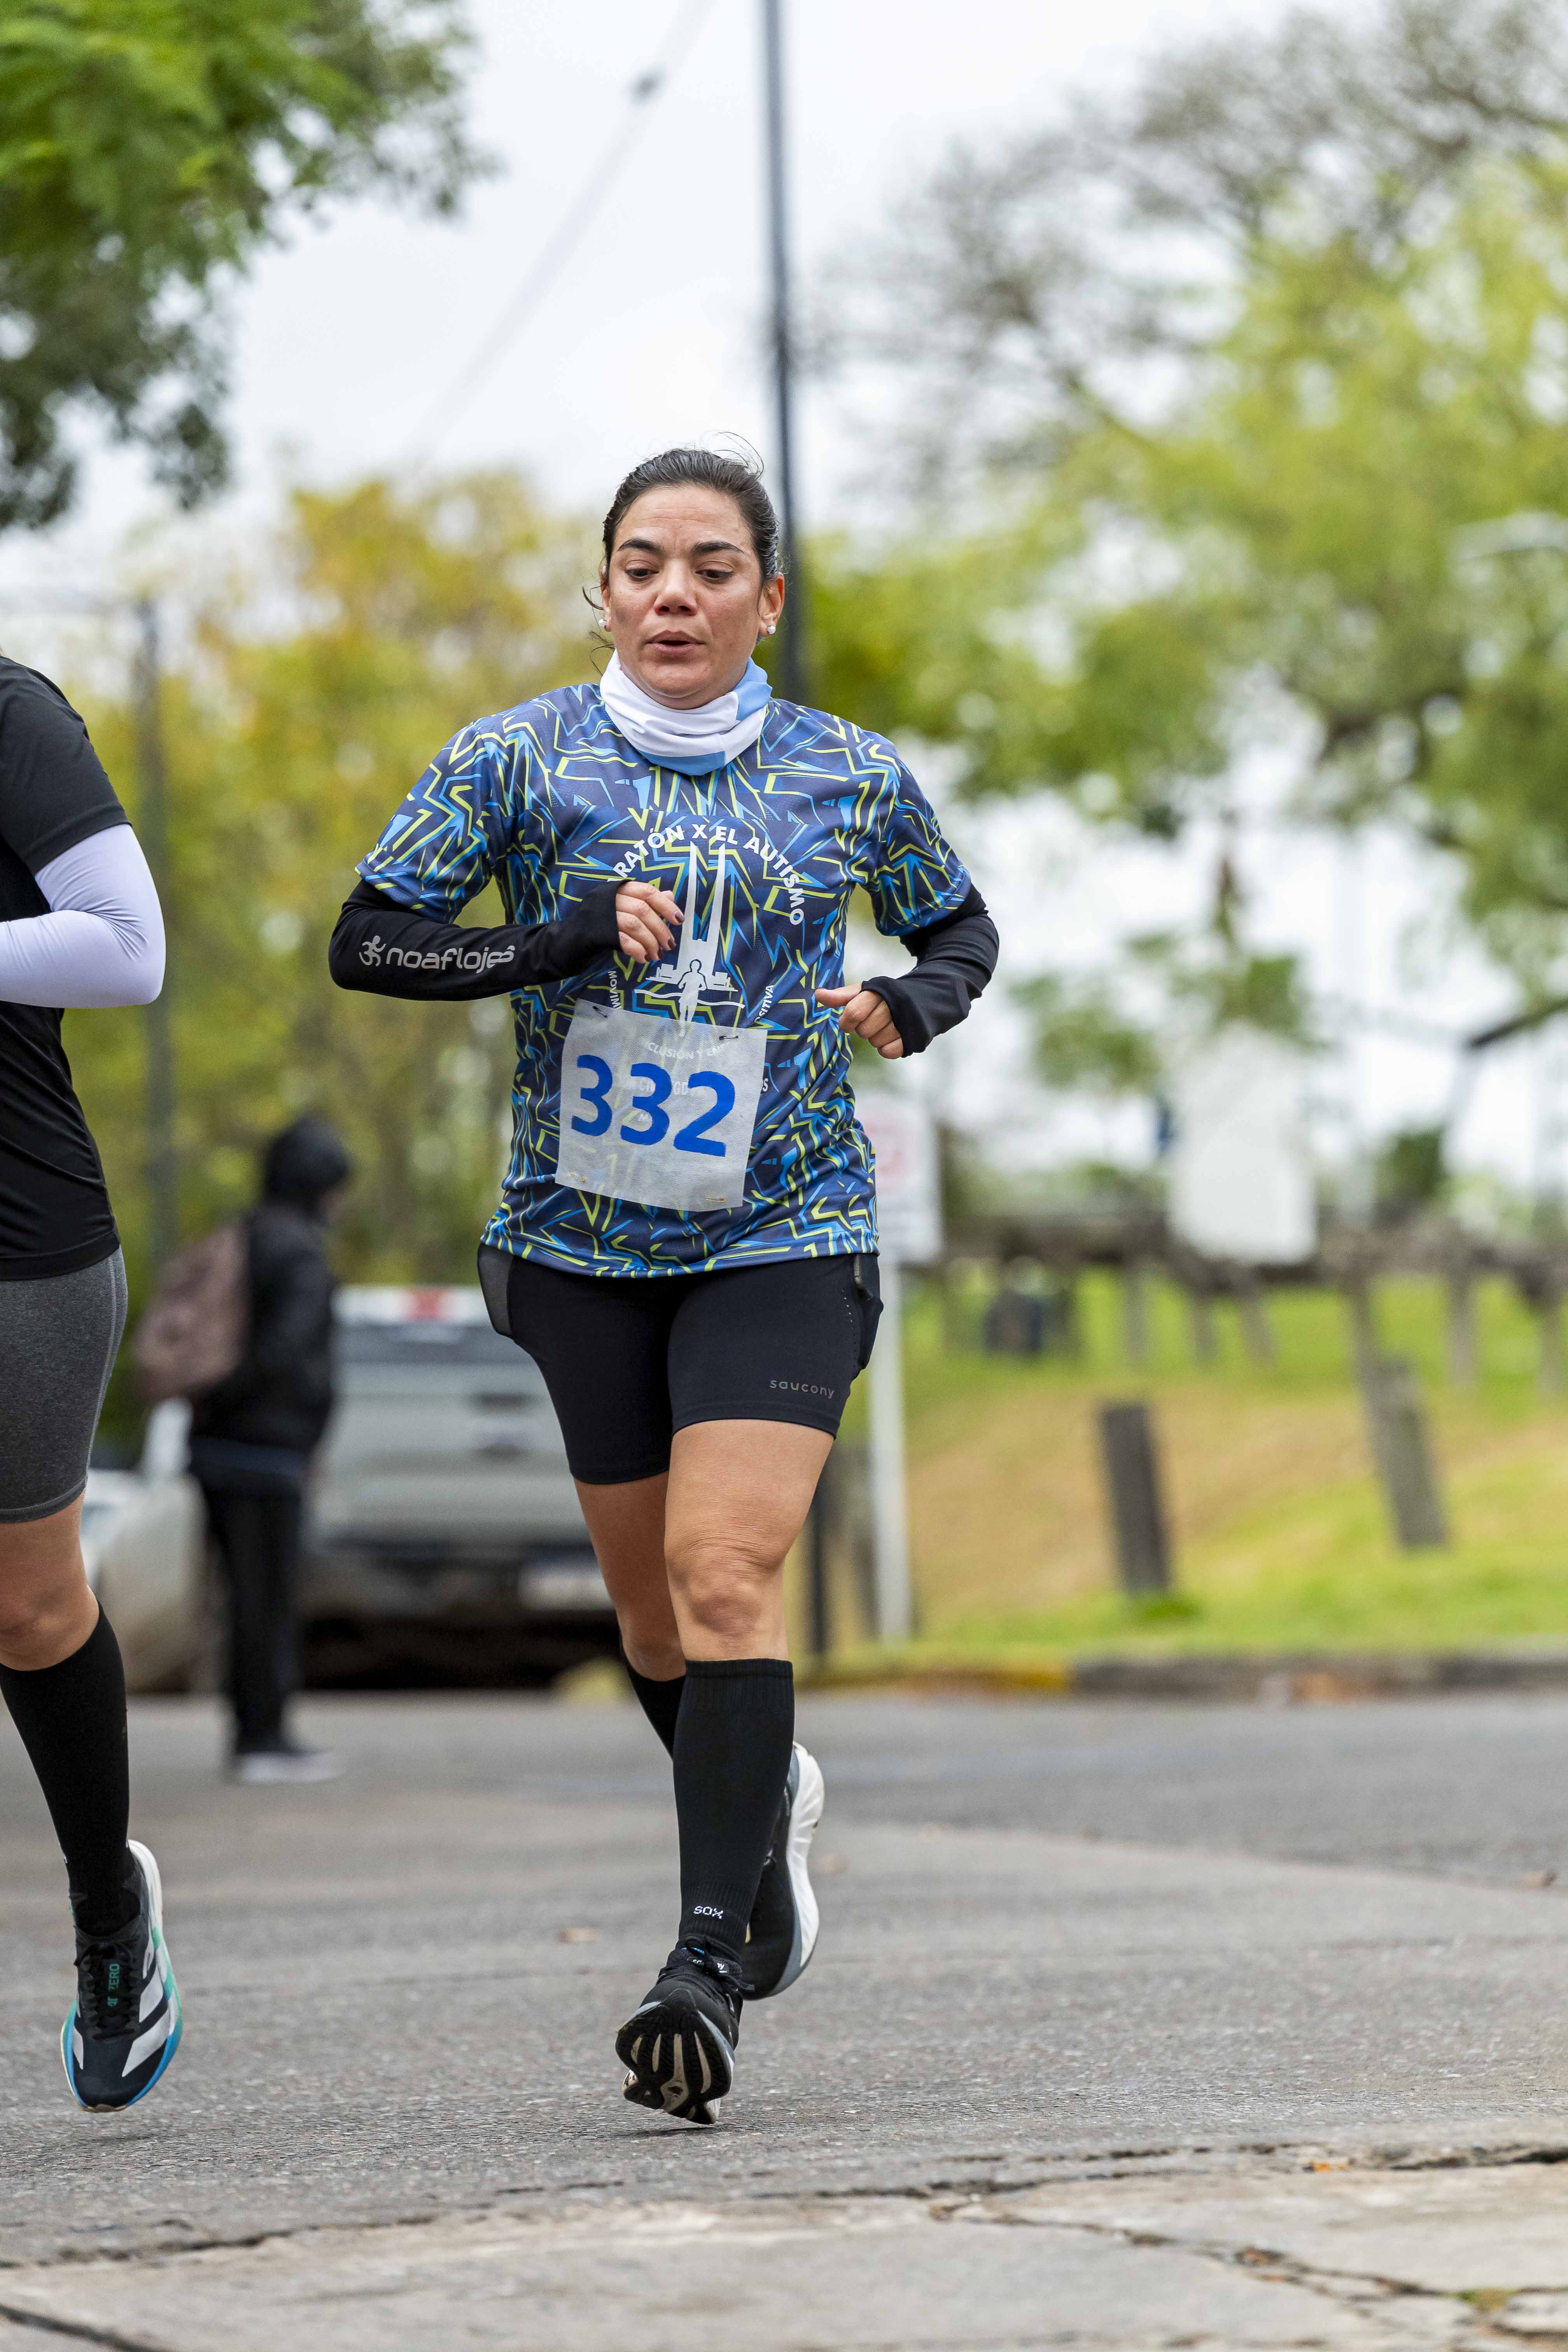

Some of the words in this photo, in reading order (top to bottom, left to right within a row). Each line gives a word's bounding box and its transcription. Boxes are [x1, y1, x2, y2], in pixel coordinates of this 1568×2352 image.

[612, 824, 685, 879] RATÓN
[691, 824, 708, 839] X
[715, 826, 738, 845] EL
[742, 836, 805, 925] AUTISMO
[571, 1054, 728, 1157] 332
[769, 1380, 835, 1399] saucony
